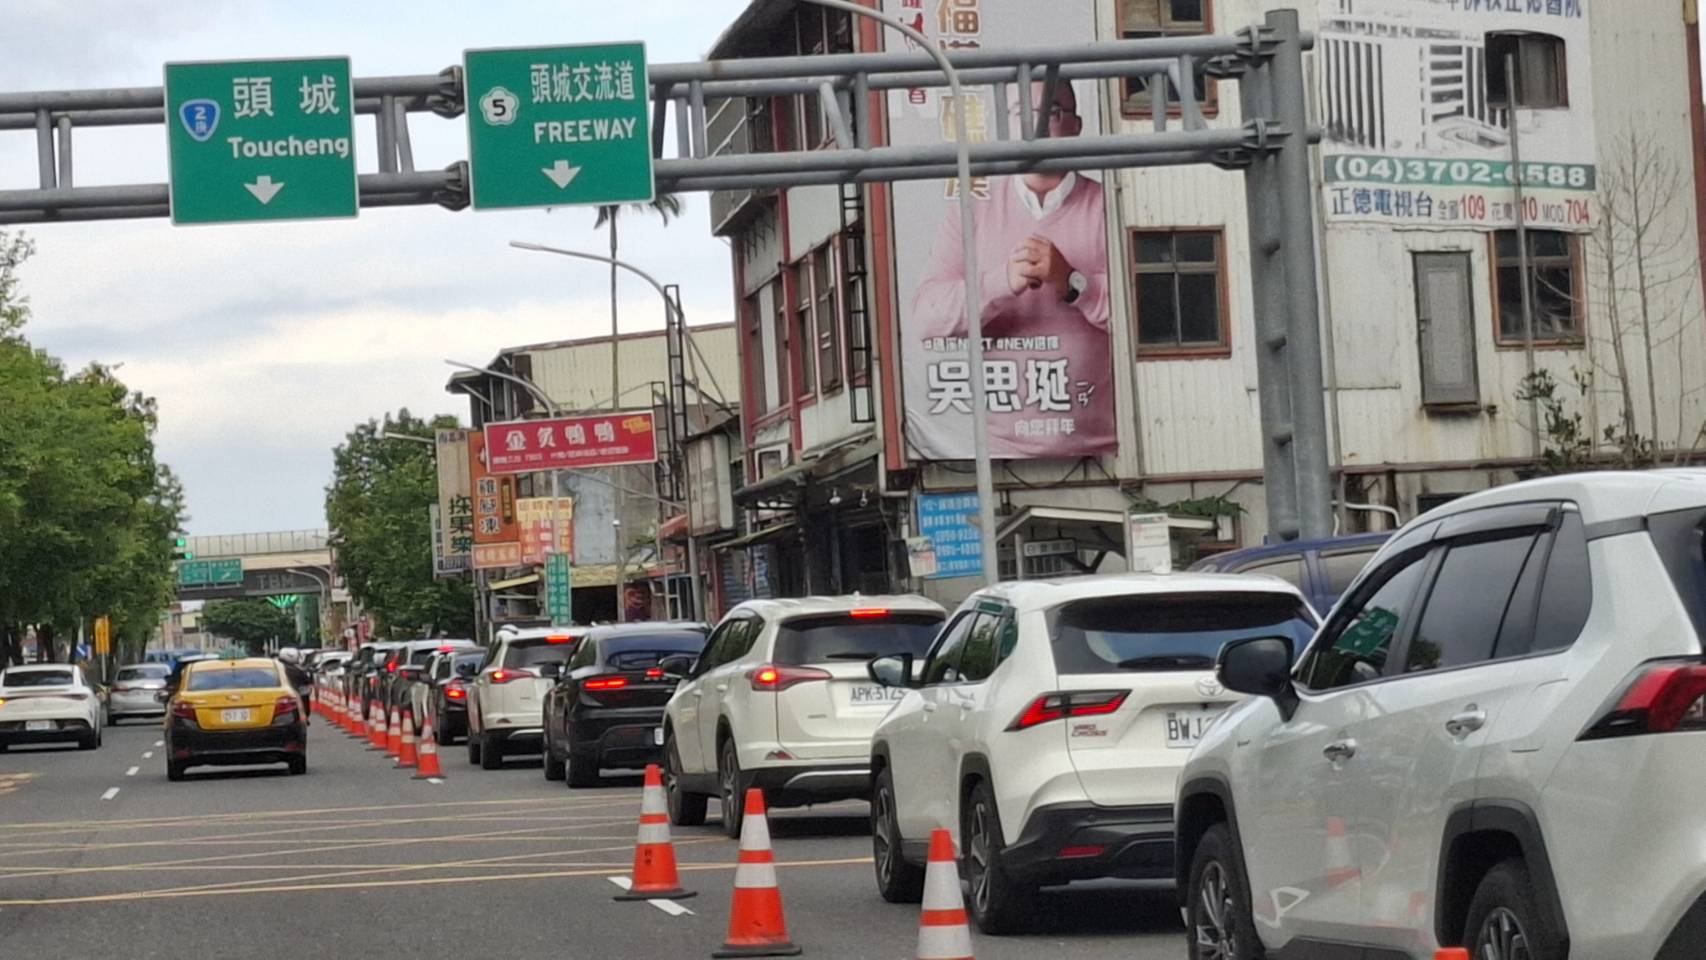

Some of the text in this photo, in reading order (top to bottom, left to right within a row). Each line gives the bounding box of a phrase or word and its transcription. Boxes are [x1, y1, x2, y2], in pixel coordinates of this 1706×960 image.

[530, 61, 636, 104] 頭城交流道
[233, 75, 340, 119] 頭城
[493, 98, 506, 118] 5
[194, 105, 207, 120] 2
[534, 118, 636, 144] FREEWAY
[228, 135, 349, 160] Toucheng
[1331, 187, 1434, 219] 正德電視台
[1460, 194, 1486, 221] 109
[1564, 199, 1590, 224] 704
